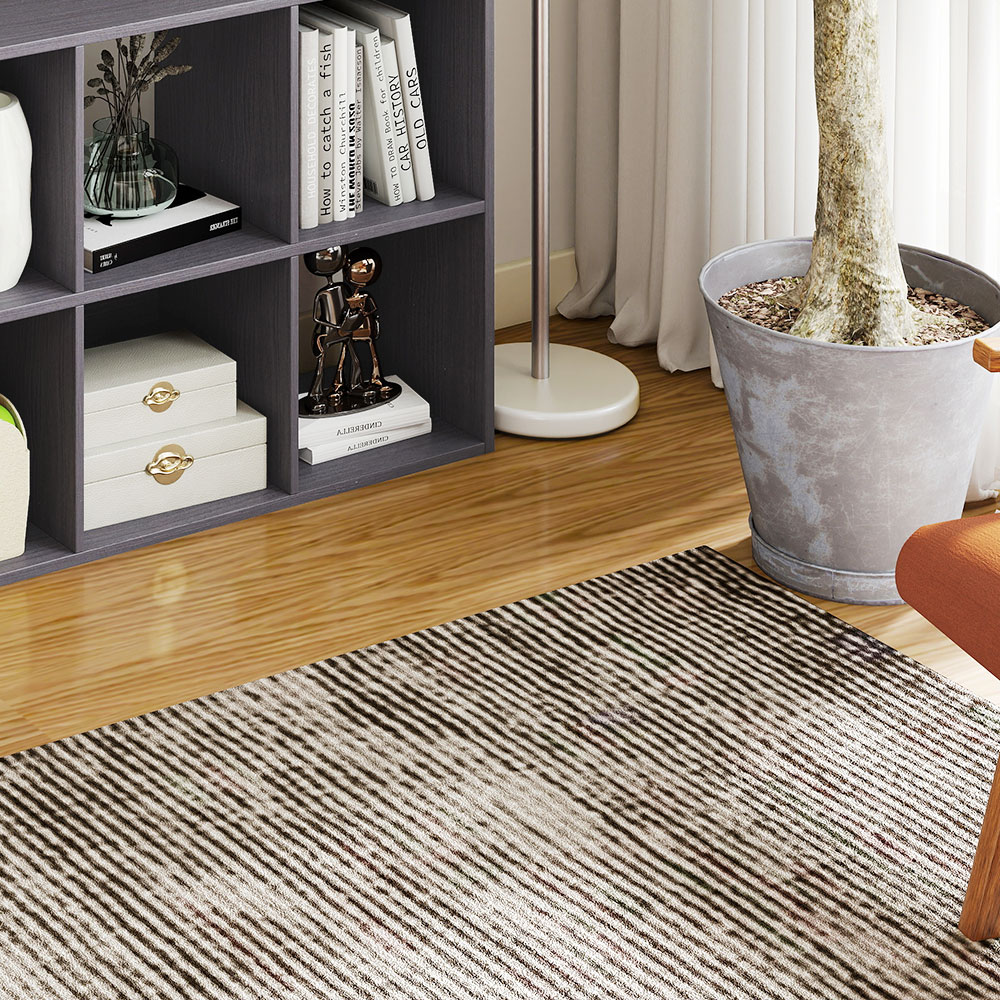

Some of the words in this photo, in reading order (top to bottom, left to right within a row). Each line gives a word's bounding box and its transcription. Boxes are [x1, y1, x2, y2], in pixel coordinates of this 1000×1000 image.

[319, 43, 332, 79] fish
[373, 35, 384, 82] children
[307, 57, 317, 125] DECORATES
[323, 89, 332, 97] a
[379, 89, 387, 104] for
[405, 67, 422, 109] CARS
[387, 75, 407, 137] HISTORY
[320, 107, 332, 152] catch
[338, 92, 347, 155] Churchill
[382, 109, 392, 134] Book
[413, 118, 427, 150] OLD
[355, 138, 362, 149] by
[386, 137, 396, 162] DRAW
[398, 143, 411, 171] CAR
[307, 131, 317, 199] HOUSEHOLD
[321, 161, 331, 179] to
[390, 166, 398, 179] TO
[320, 188, 331, 216] How
[339, 161, 347, 213] Winston
[393, 182, 401, 202] HOW
